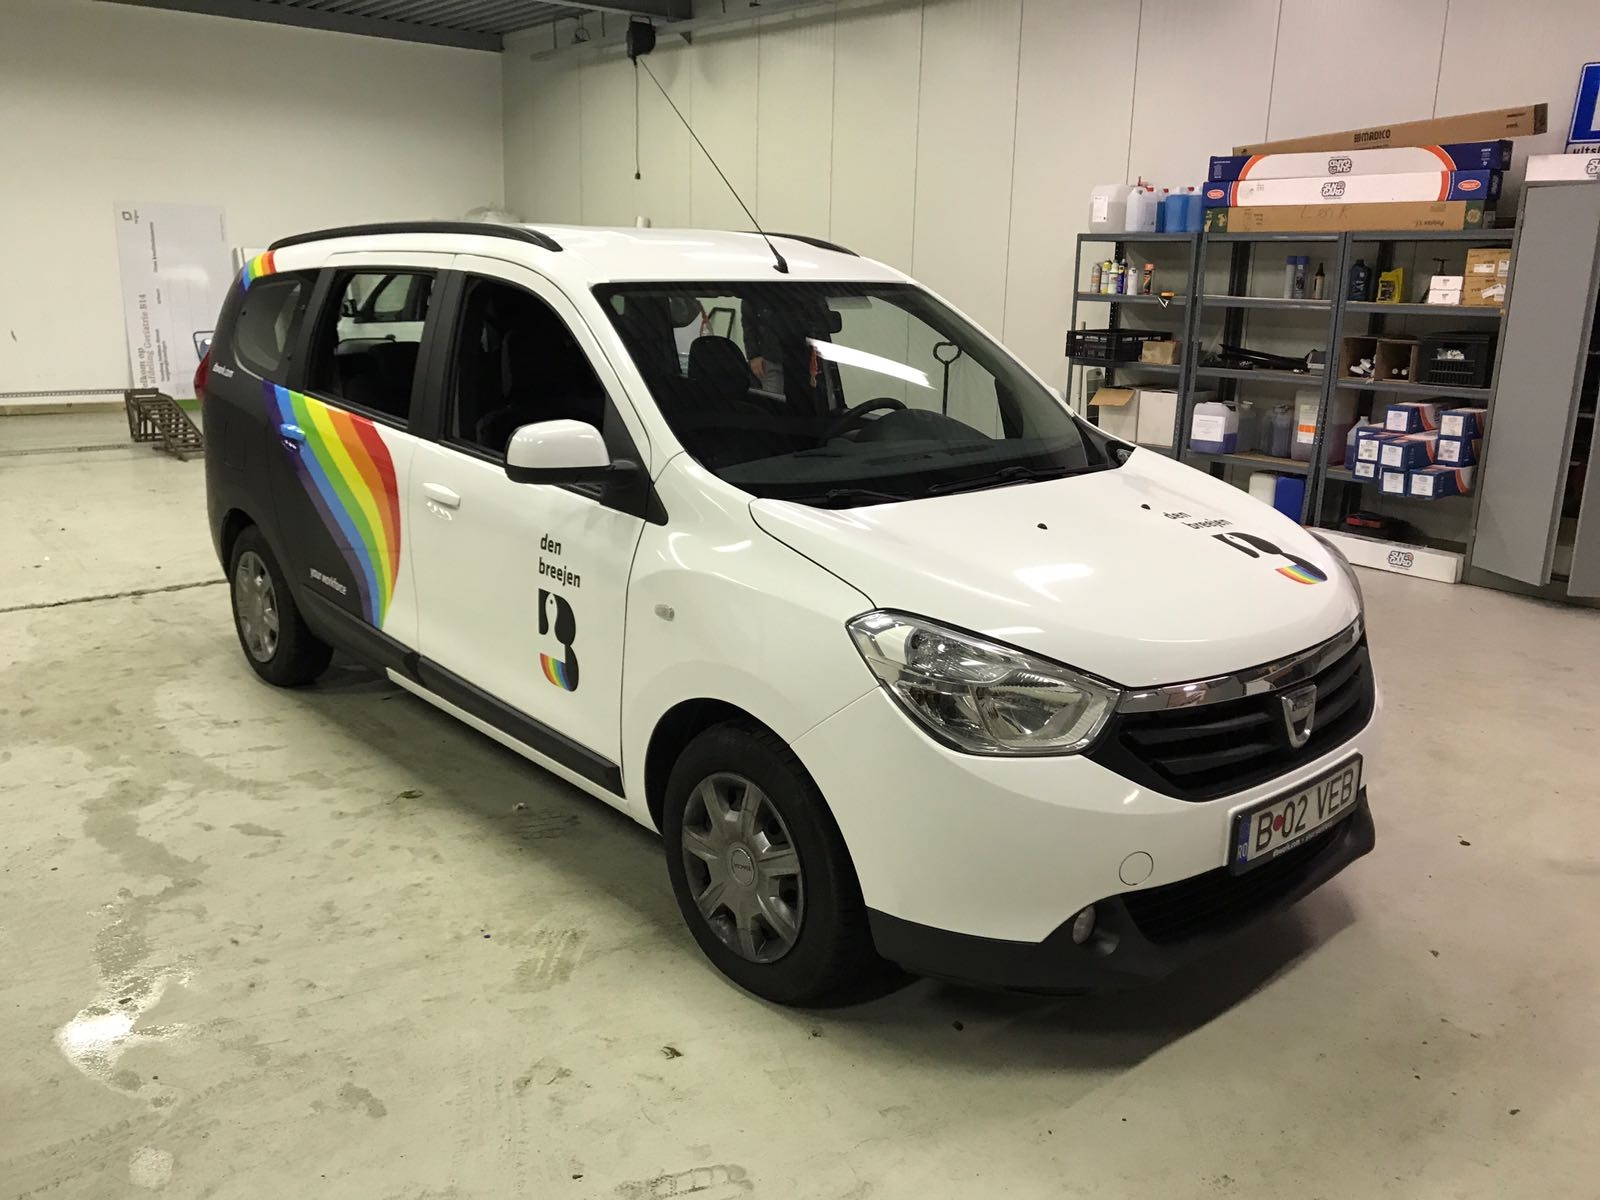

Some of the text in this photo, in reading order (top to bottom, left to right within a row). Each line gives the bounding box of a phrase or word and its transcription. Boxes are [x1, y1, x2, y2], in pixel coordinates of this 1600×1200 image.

[1361, 129, 1391, 142] MADICO
[138, 294, 148, 310] B14
[1163, 511, 1192, 519] den
[1181, 518, 1233, 529] breejen
[540, 533, 562, 555] den
[538, 556, 581, 588] breejen
[1256, 810, 1273, 852] B
[1281, 795, 1308, 838] 02
[1317, 767, 1354, 820] VEB
